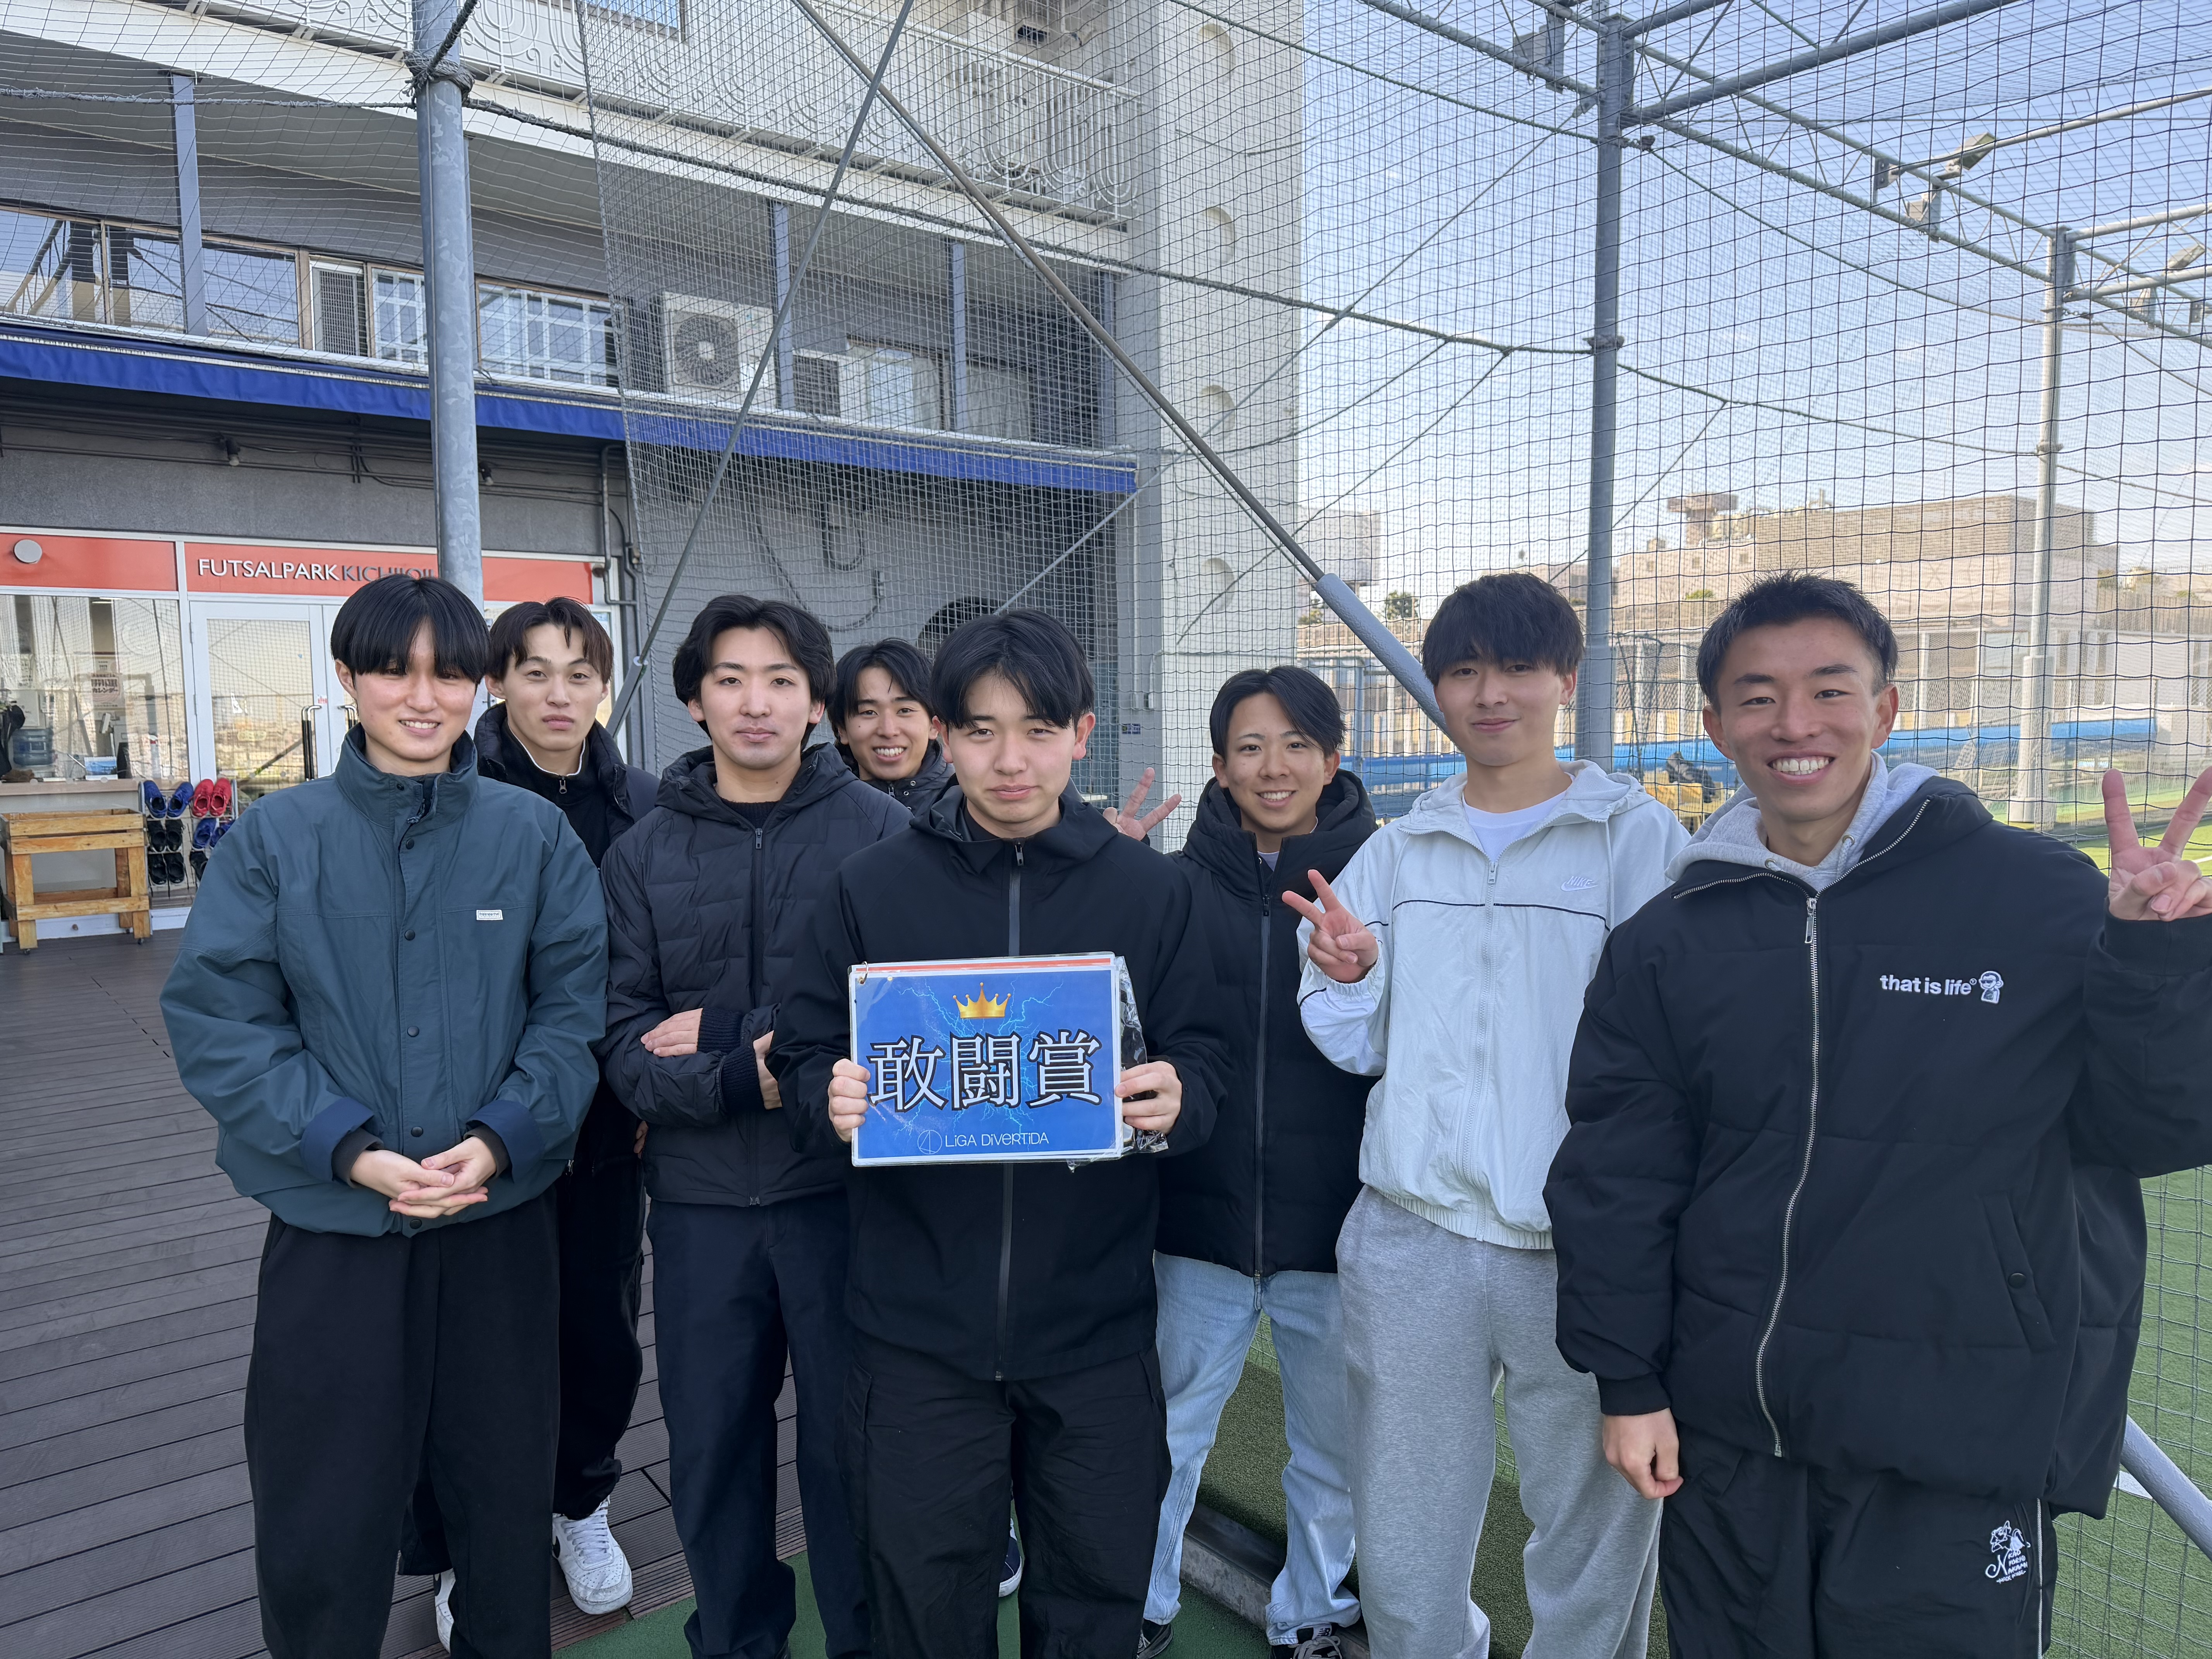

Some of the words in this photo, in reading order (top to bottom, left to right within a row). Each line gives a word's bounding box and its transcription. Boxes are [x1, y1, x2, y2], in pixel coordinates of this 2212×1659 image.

[199, 559, 340, 580] FUTSALPARK
[1567, 876, 1595, 887] NIKE
[1880, 975, 1921, 993] that
[1924, 977, 1942, 994] is
[1944, 979, 1972, 995] life
[866, 1028, 1103, 1113] 敢闘賞
